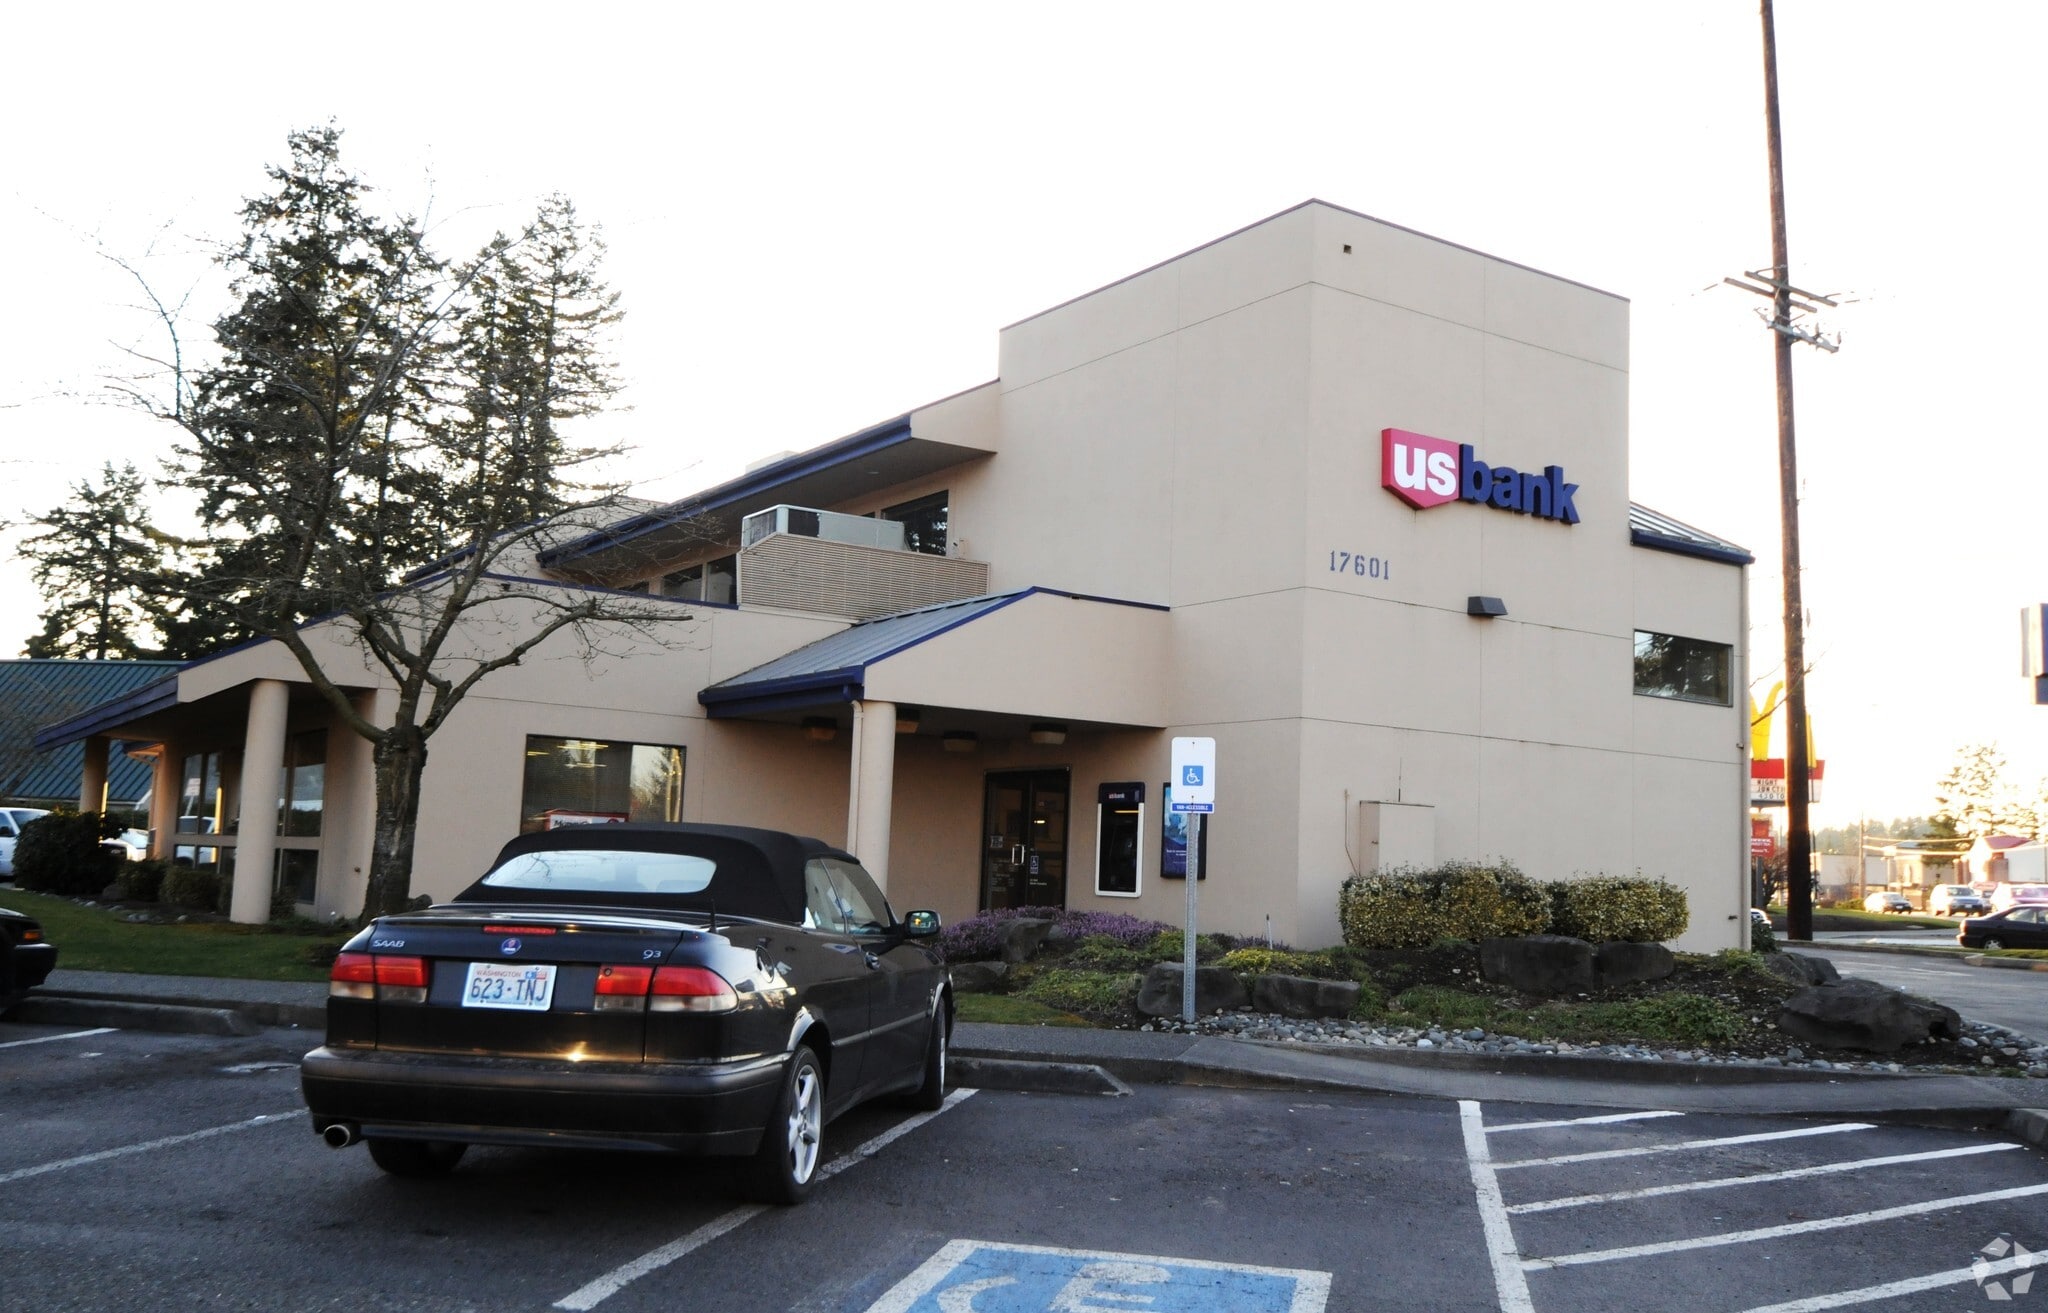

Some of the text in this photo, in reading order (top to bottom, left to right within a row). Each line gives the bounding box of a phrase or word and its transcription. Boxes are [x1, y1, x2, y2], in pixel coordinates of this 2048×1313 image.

[1329, 550, 1389, 580] 17601
[373, 940, 405, 948] SAAB
[476, 969, 521, 978] WASHINGTON
